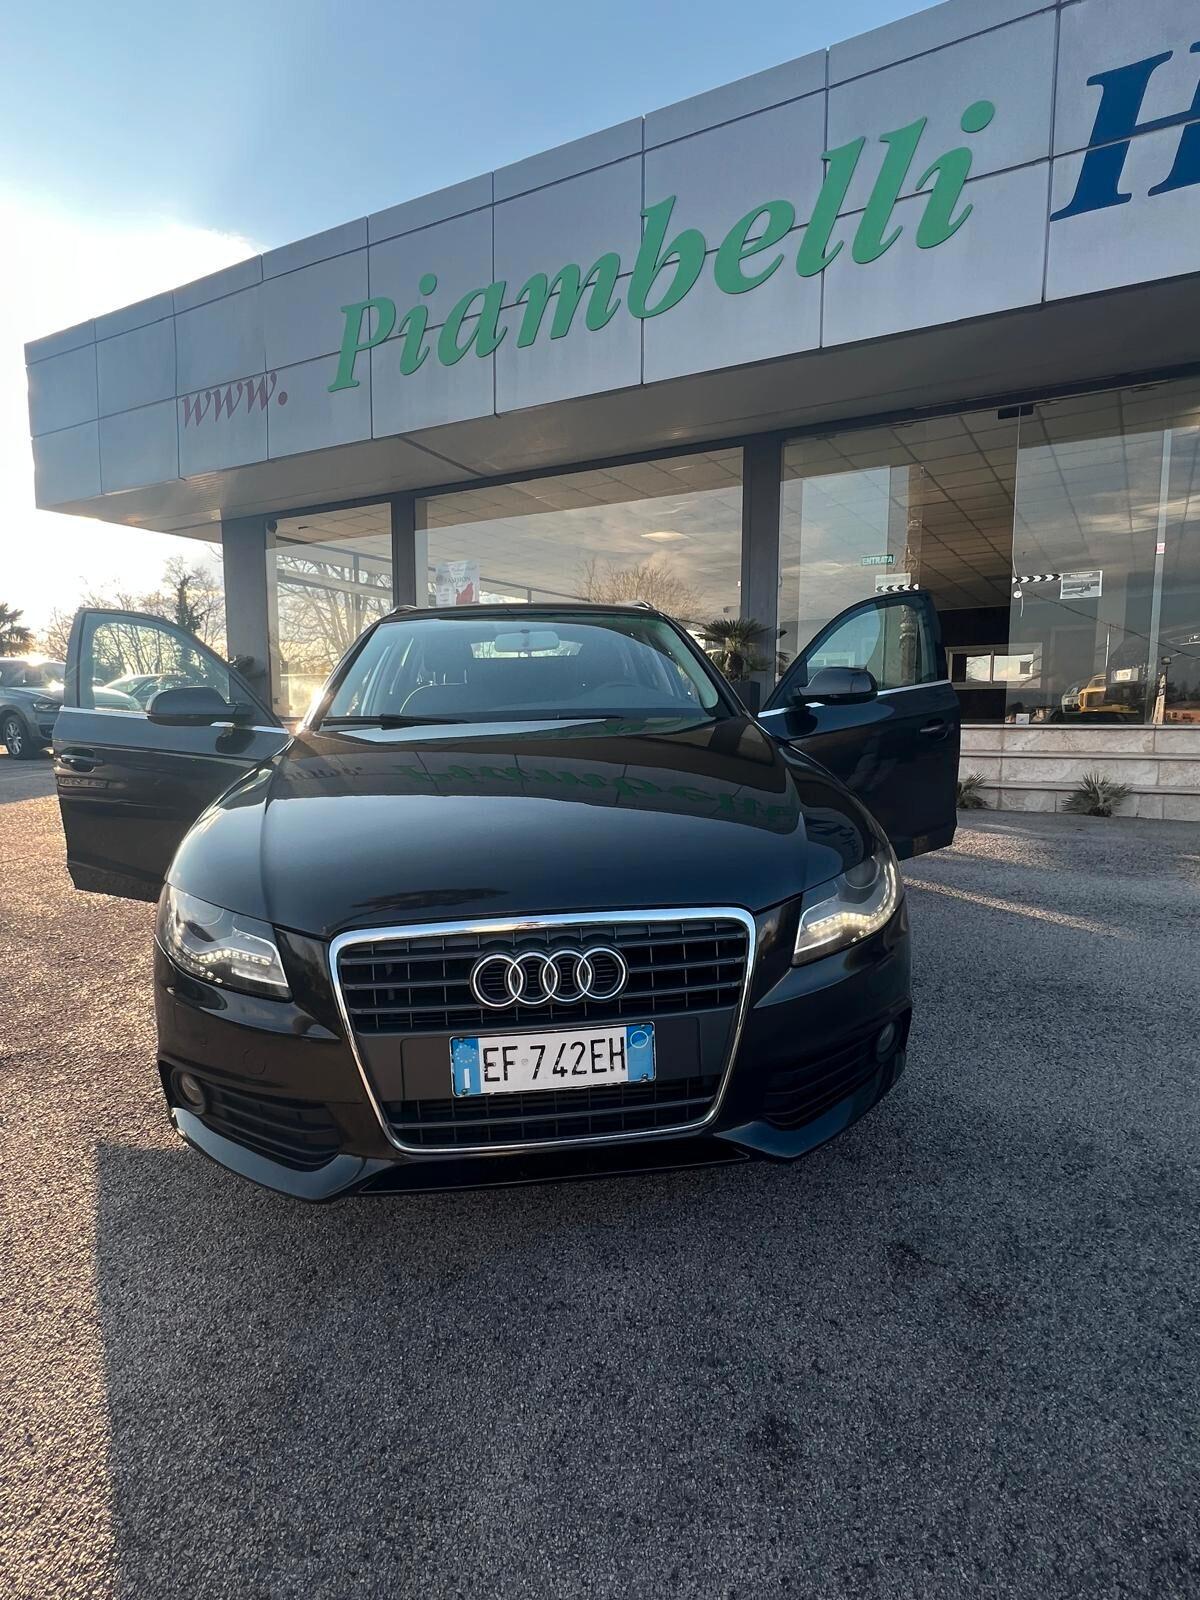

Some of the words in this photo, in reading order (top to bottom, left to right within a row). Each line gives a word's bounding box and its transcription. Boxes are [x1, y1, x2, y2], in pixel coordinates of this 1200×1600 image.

[182, 371, 288, 428] www.
[328, 100, 996, 393] Piambelli
[862, 555, 893, 564] ENTRATA
[483, 1045, 518, 1083] EF
[529, 1037, 626, 1080] 742EH
